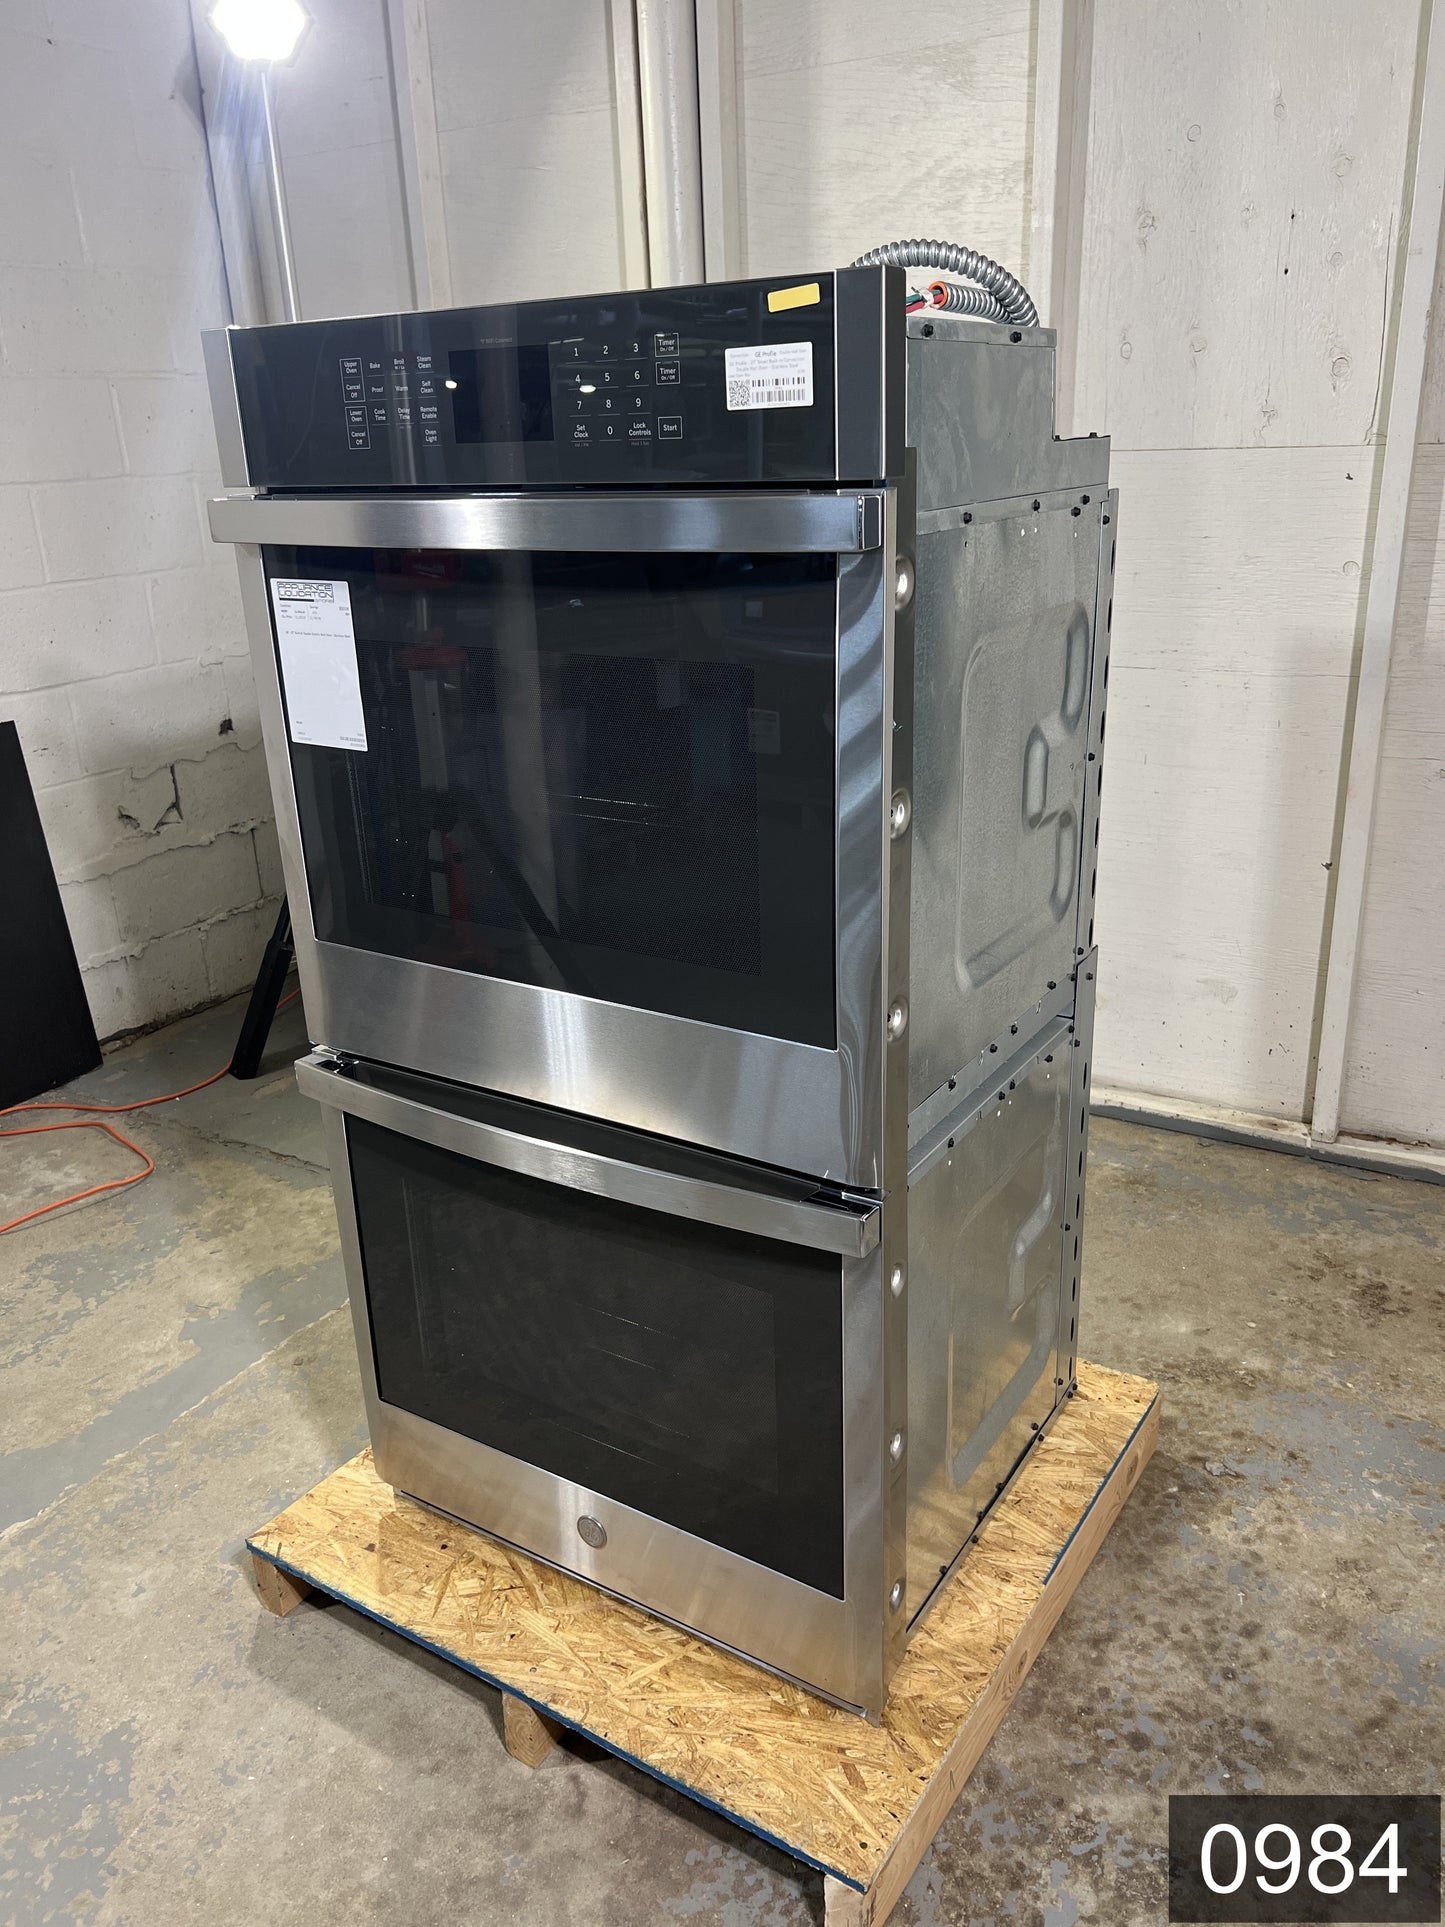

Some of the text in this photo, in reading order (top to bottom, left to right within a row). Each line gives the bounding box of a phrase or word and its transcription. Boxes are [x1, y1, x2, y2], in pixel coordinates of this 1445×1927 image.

[603, 346, 608, 354] 2
[633, 343, 639, 352] 3
[574, 348, 578, 356] 1
[575, 374, 580, 383] 4
[605, 373, 610, 381] 5
[635, 371, 640, 379] 6
[577, 401, 582, 409] 7
[606, 400, 612, 408] 8
[636, 398, 641, 407] 9
[608, 426, 613, 435] 0
[278, 583, 332, 591] APPLIANCE
[280, 590, 333, 598] LIQUIDATION
